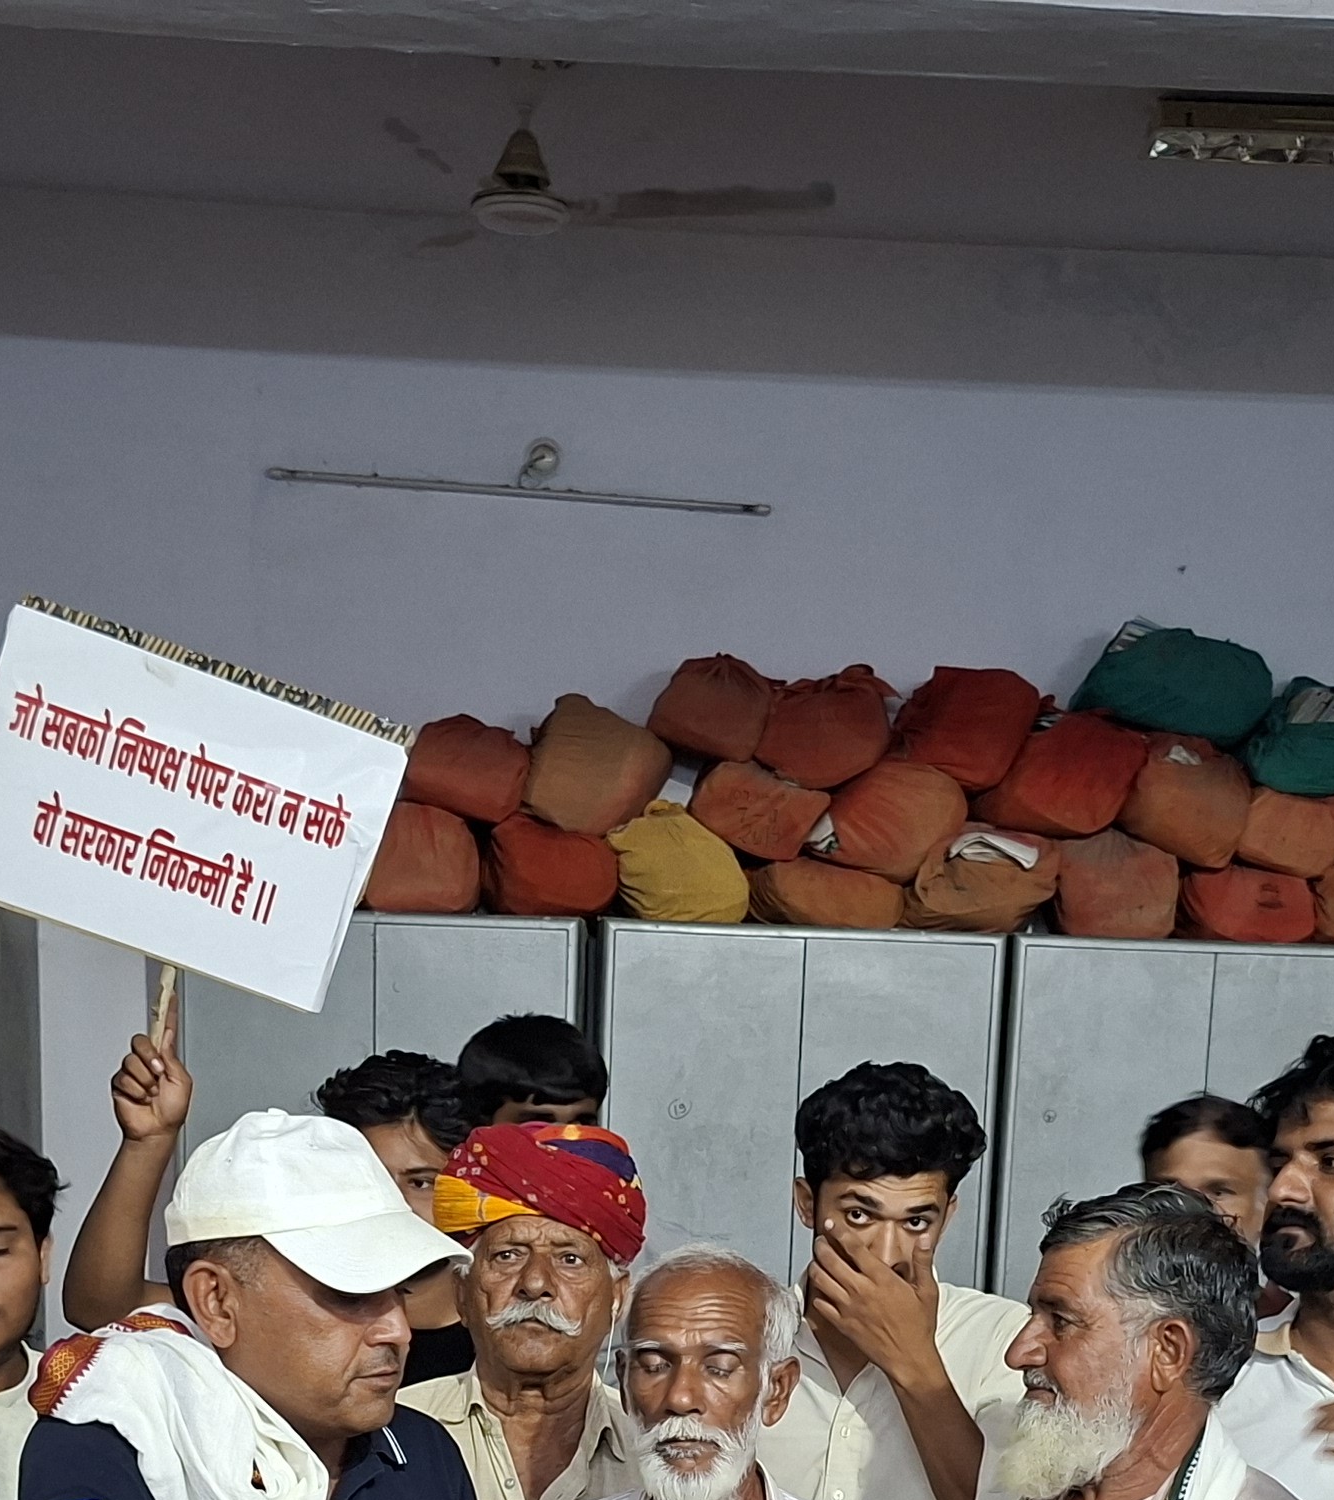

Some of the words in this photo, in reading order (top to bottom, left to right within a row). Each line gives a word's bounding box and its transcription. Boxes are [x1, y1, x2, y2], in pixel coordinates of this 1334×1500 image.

[8, 684, 45, 741] जो
[40, 708, 112, 765] सबको
[108, 717, 187, 793] निष्पक्ष
[185, 743, 235, 810] पेपर
[232, 772, 281, 827] करा
[278, 790, 307, 836] न
[301, 793, 352, 851] सके
[31, 791, 61, 848] वो
[60, 811, 143, 876] सरकार
[139, 827, 234, 910] निकम्मी
[229, 857, 255, 916] है
